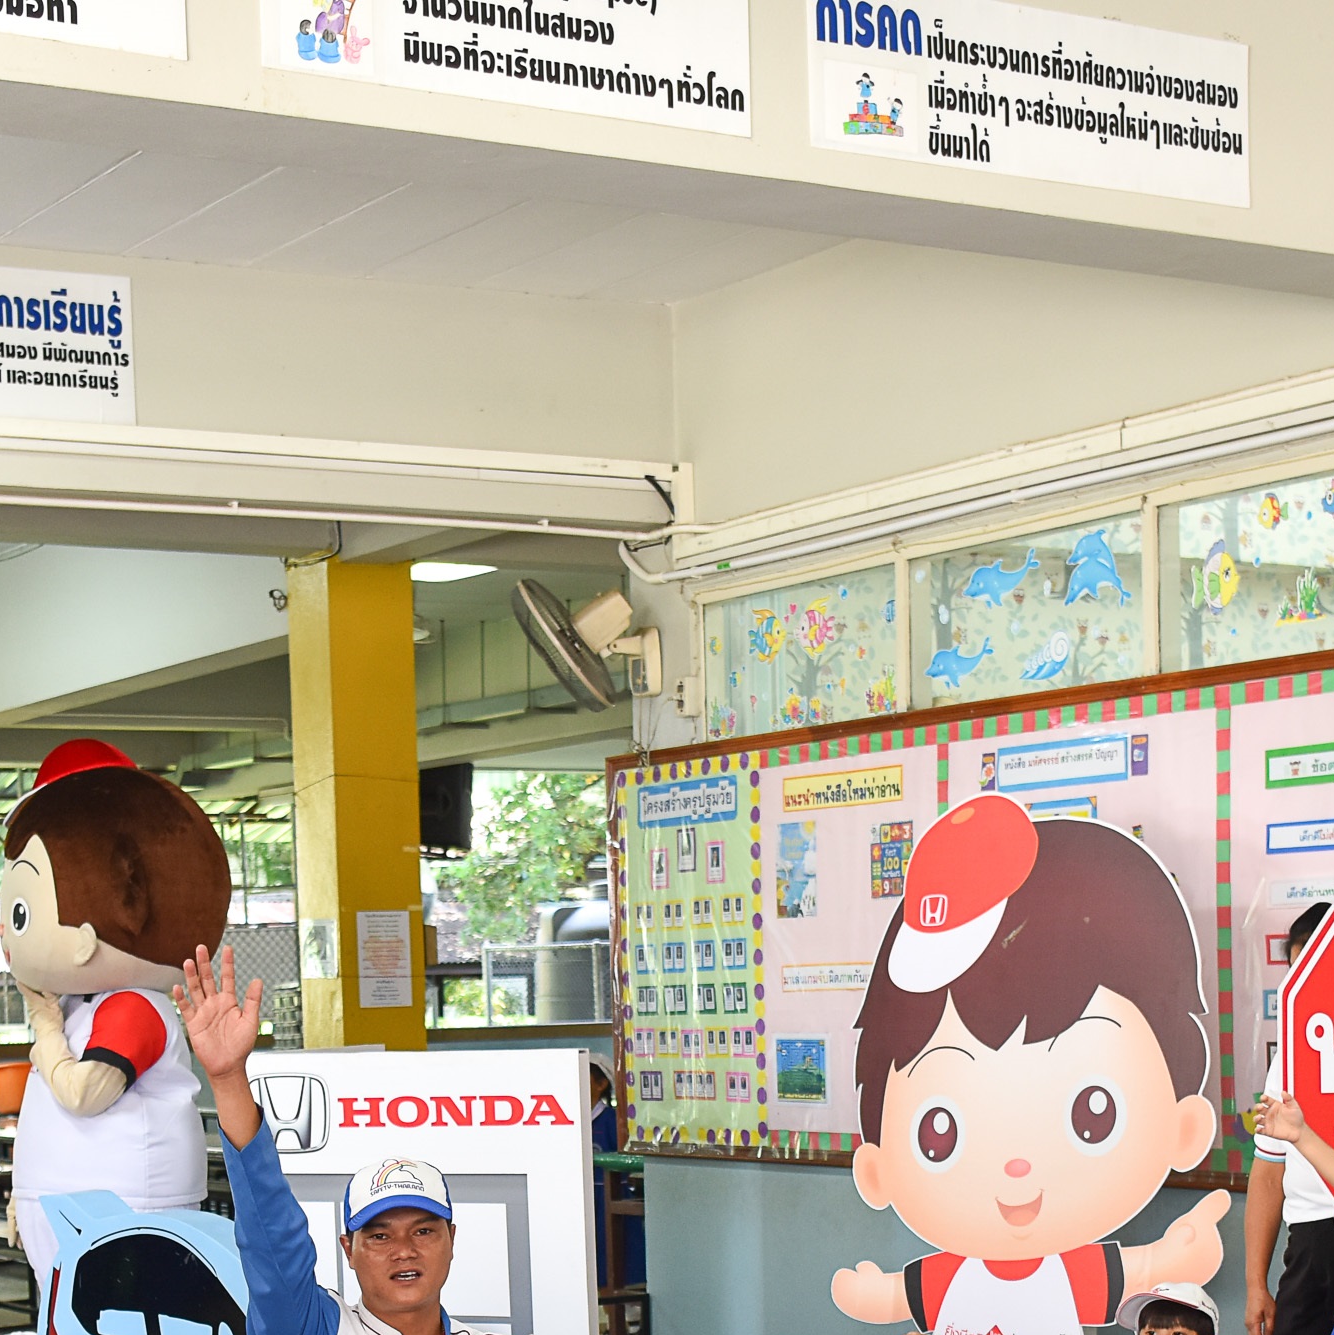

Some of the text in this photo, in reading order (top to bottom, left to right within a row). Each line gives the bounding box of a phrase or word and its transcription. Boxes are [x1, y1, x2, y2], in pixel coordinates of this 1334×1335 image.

[928, 114, 991, 163] ขึ้นมาได้
[883, 857, 900, 871] 100
[883, 880, 890, 894] 9
[337, 1095, 575, 1129] HONDA
